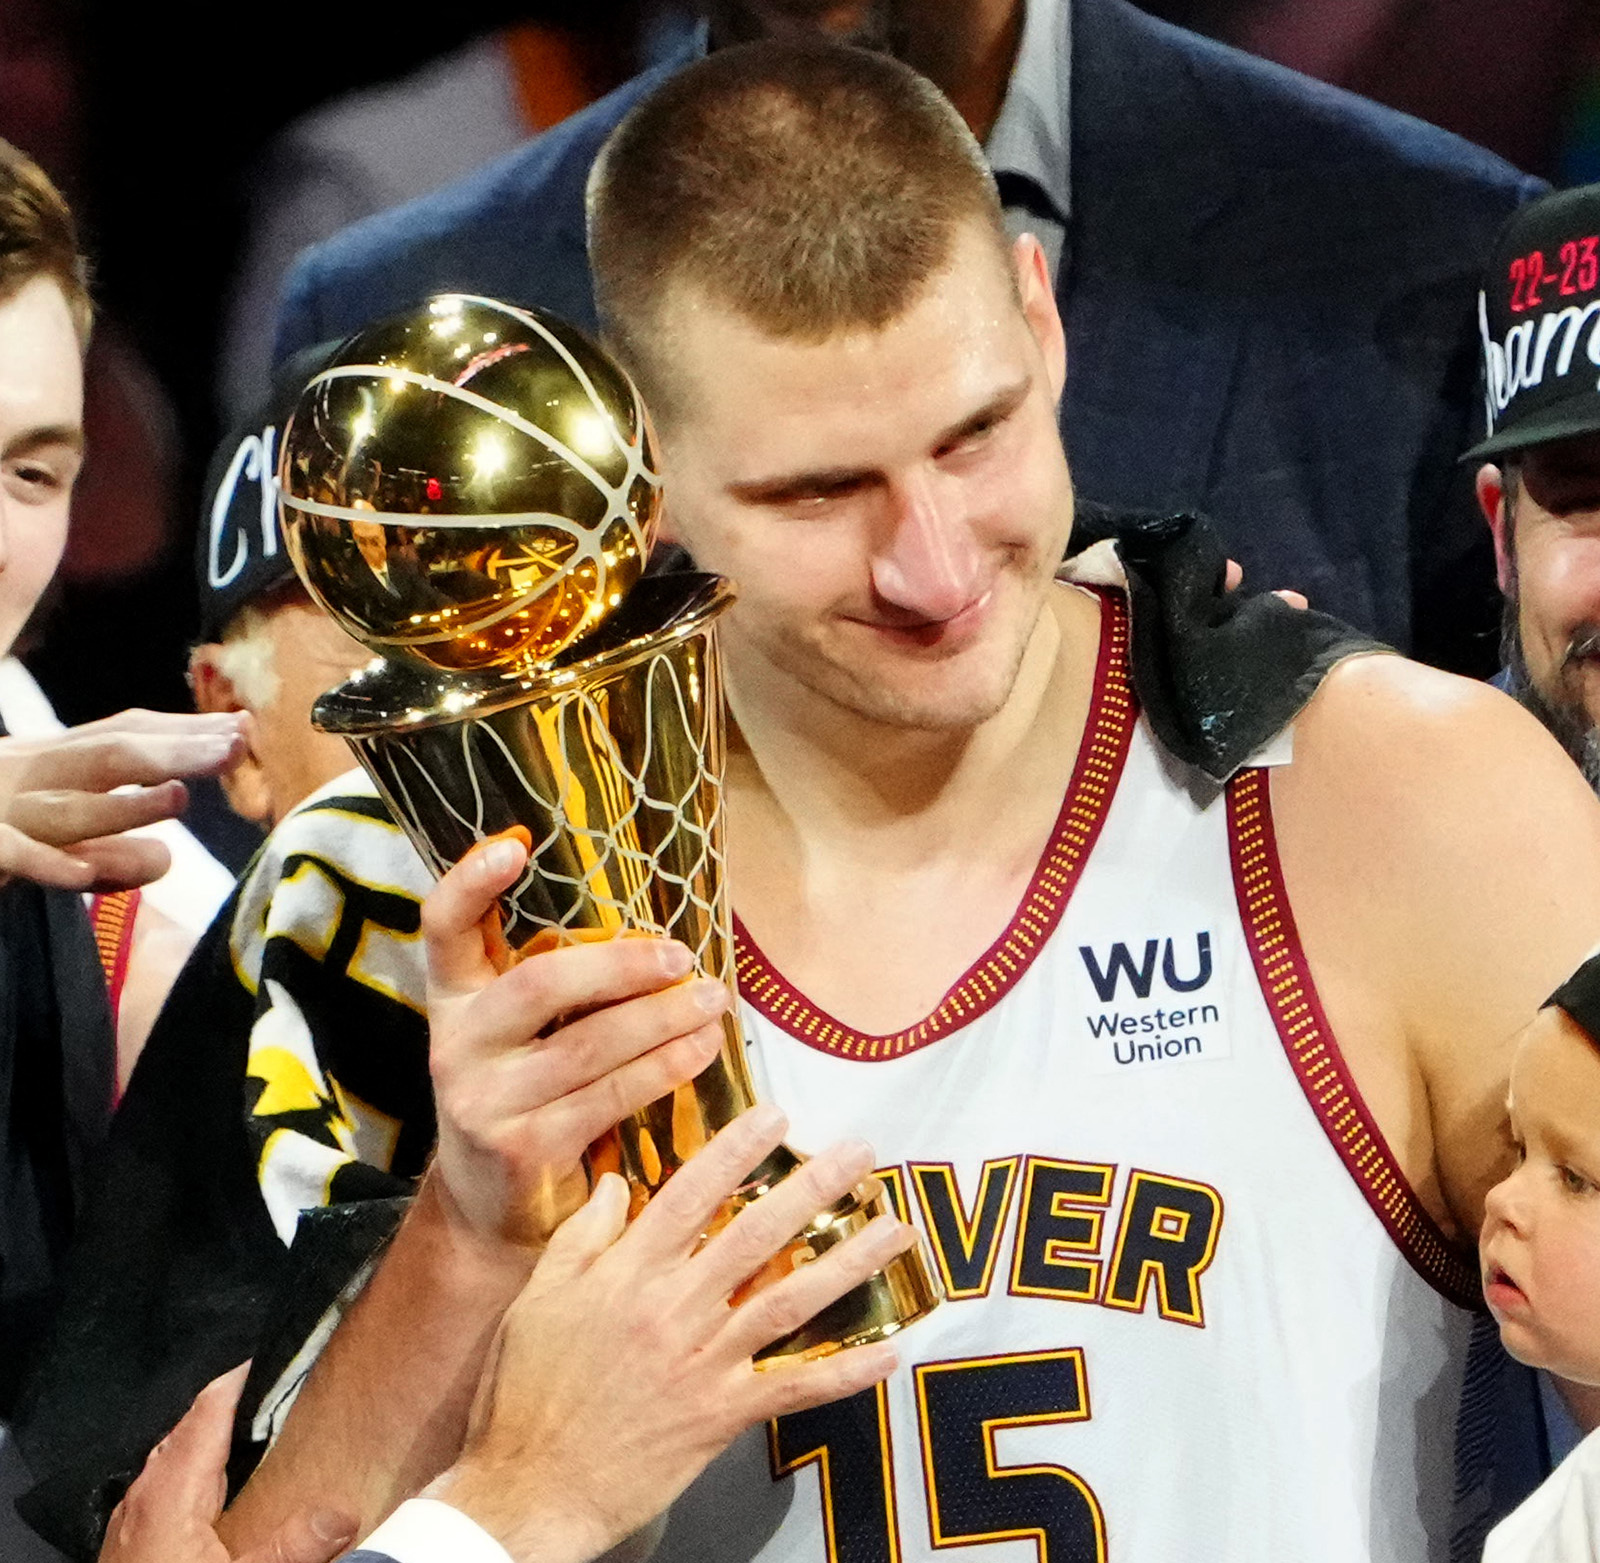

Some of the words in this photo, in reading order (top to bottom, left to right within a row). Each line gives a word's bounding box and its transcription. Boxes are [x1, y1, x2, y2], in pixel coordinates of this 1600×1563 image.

[1509, 235, 1600, 313] 22-23
[1078, 931, 1212, 1003] WU
[1087, 1004, 1219, 1039] Western
[1114, 1034, 1202, 1065] Union
[872, 1153, 1225, 1329] VER
